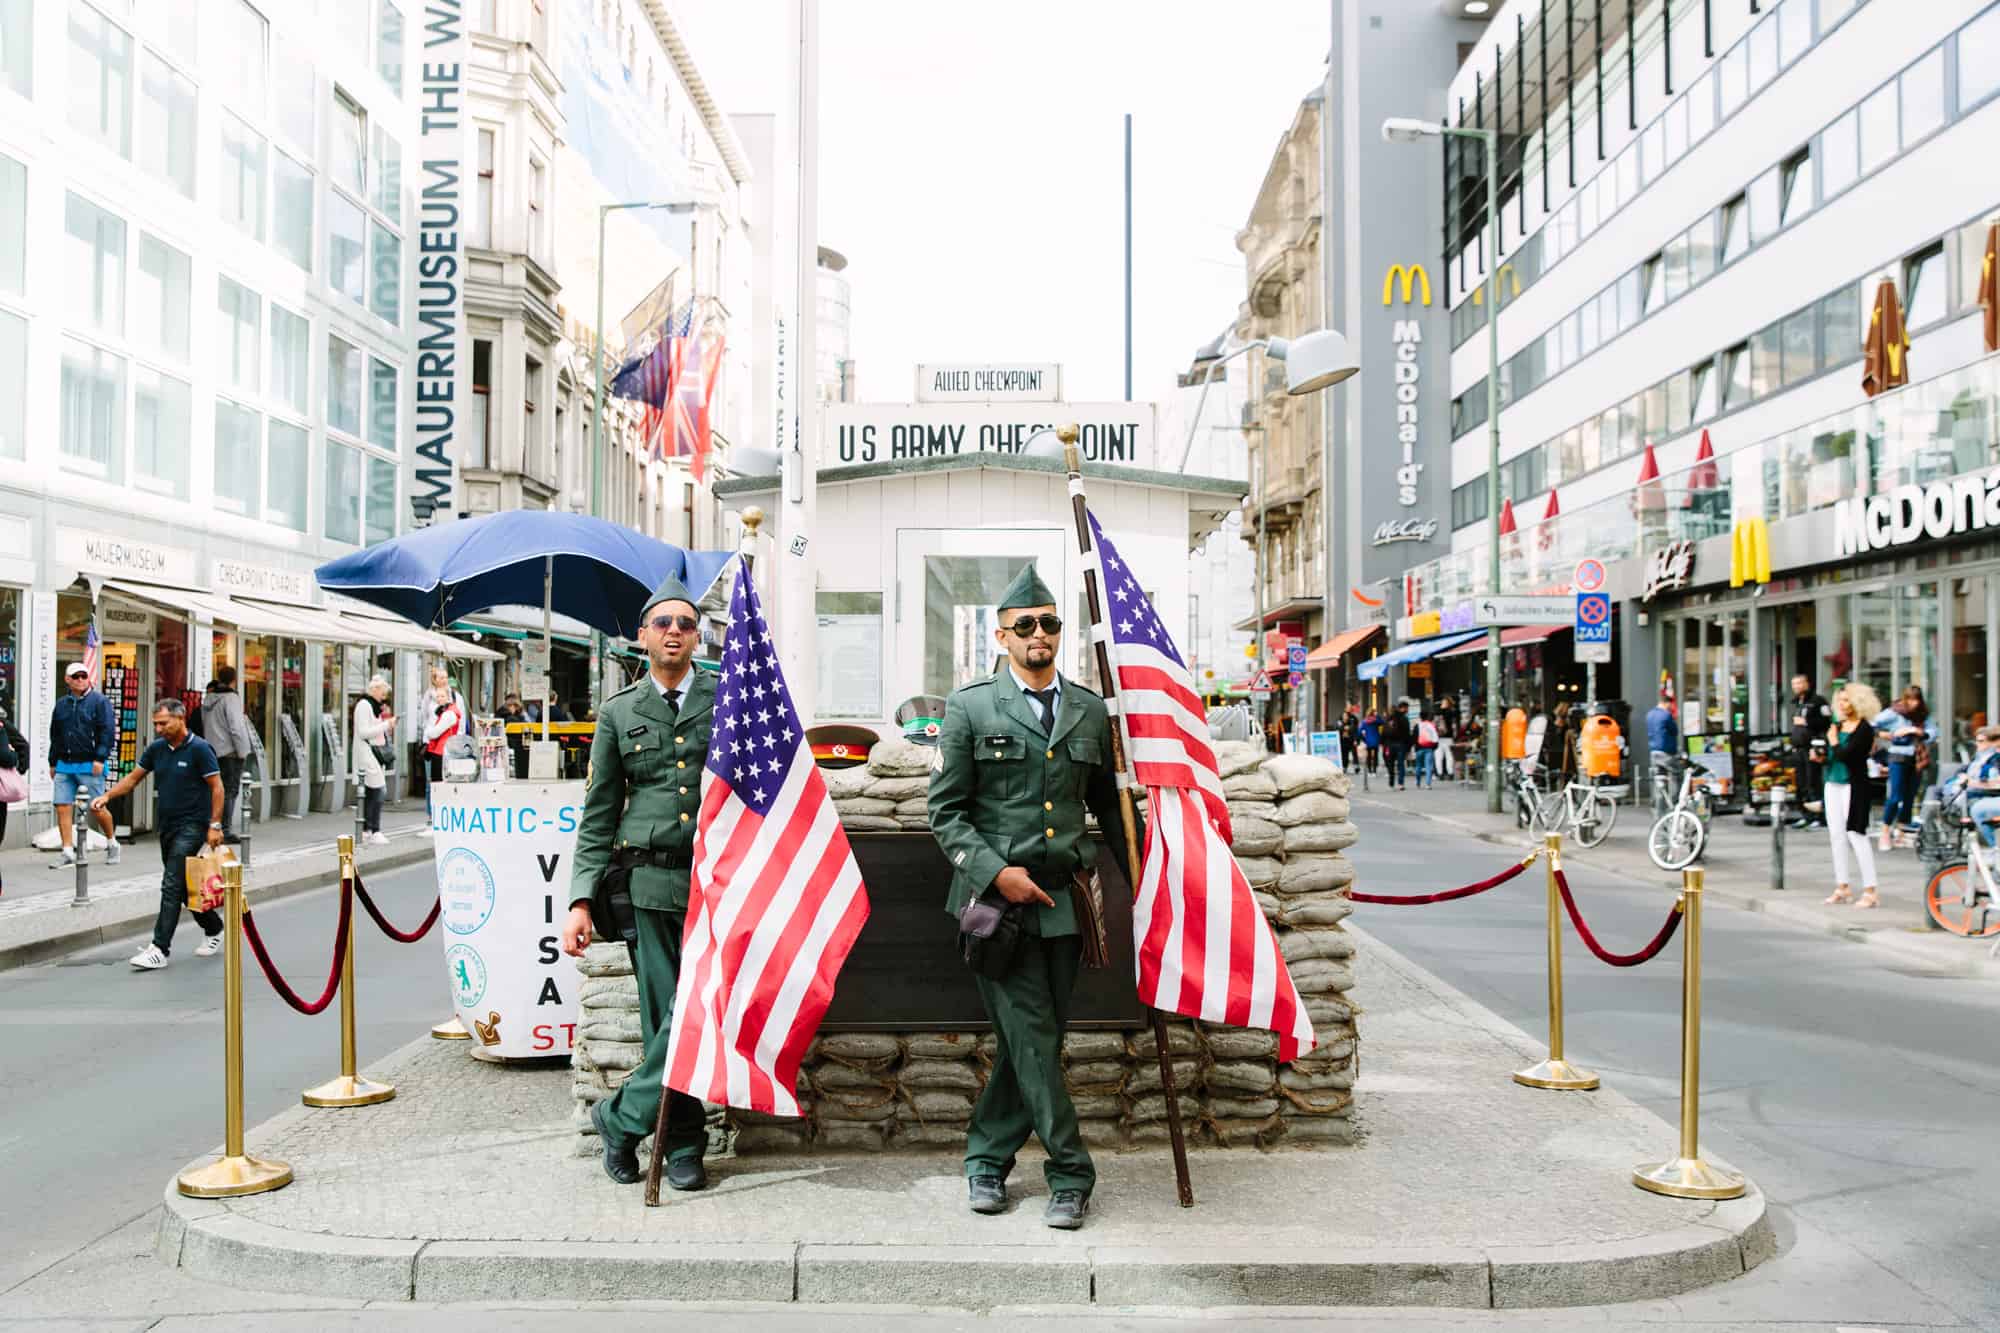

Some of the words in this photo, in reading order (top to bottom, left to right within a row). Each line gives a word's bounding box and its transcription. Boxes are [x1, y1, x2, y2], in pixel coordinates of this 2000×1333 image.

[421, 63, 459, 136] THE
[414, 160, 459, 509] MAUERMUSEUM
[934, 370, 970, 392] ALLIED
[974, 370, 1043, 391] CHECKPOINT
[839, 424, 876, 462] US
[891, 424, 966, 458] ARMY
[86, 540, 166, 572] MAUERMUSEUM
[218, 563, 268, 586] CHECKPOINT
[270, 573, 301, 596] CHARLIE
[1578, 627, 1608, 640] TAXI
[432, 806, 582, 834] LOMATIC-S
[536, 854, 563, 1006] VISA
